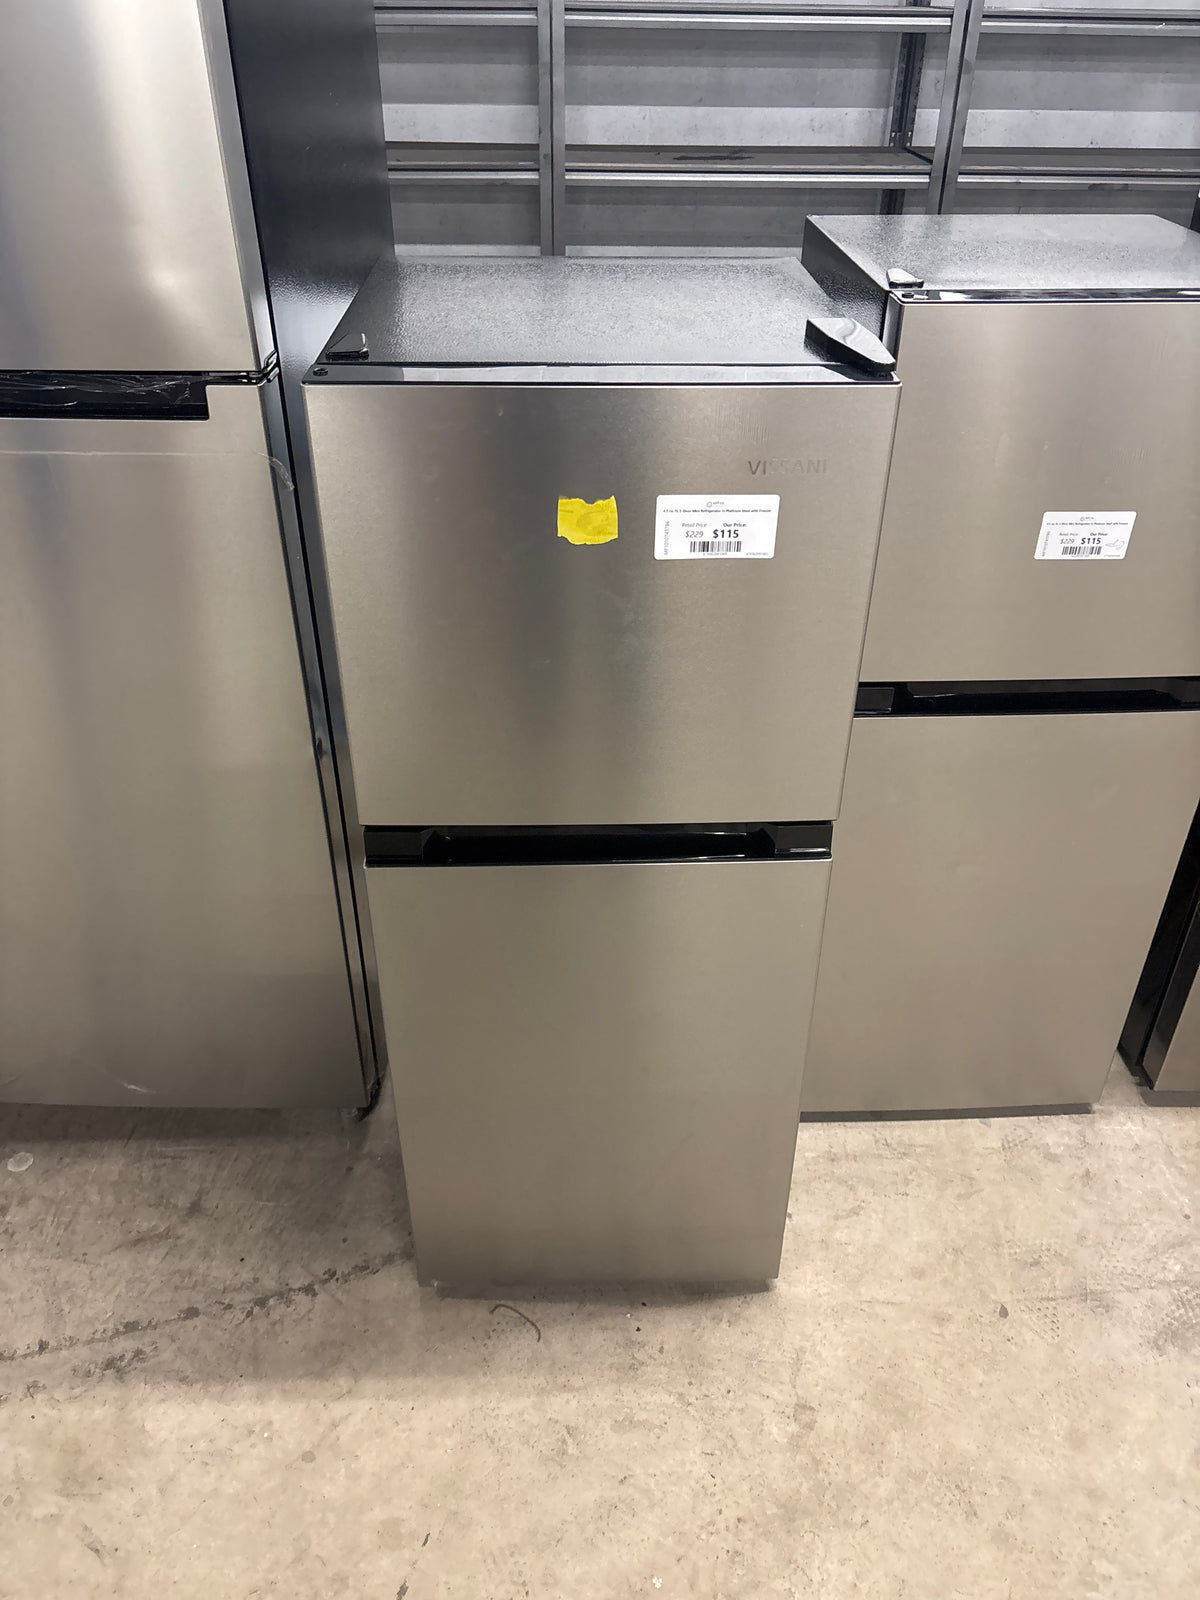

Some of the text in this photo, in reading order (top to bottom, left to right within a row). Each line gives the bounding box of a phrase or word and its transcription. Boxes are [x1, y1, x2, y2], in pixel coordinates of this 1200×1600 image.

[685, 530, 704, 538] $229
[713, 529, 739, 539] $115
[1081, 537, 1102, 545] $115
